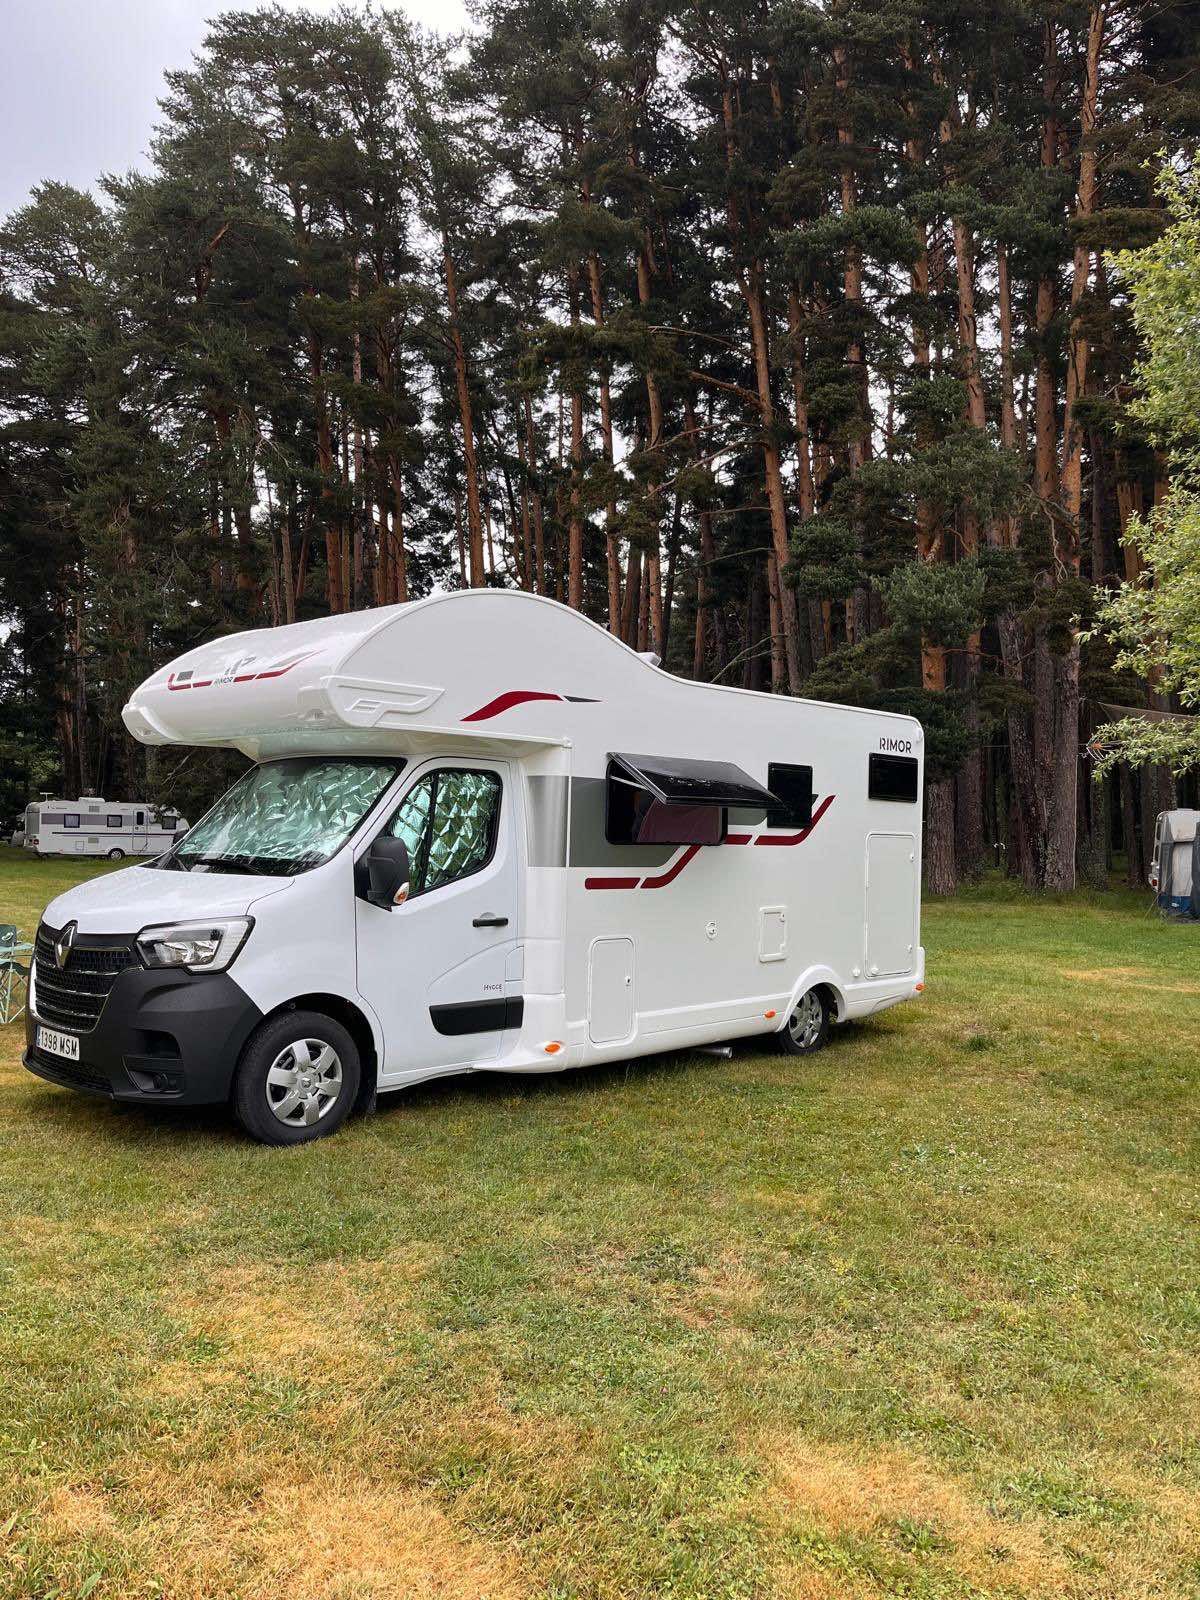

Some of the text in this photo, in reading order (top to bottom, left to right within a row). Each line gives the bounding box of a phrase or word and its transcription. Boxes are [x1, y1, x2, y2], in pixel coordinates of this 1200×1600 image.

[879, 737, 912, 754] RIMOR
[41, 1031, 77, 1056] 1398 MSM
